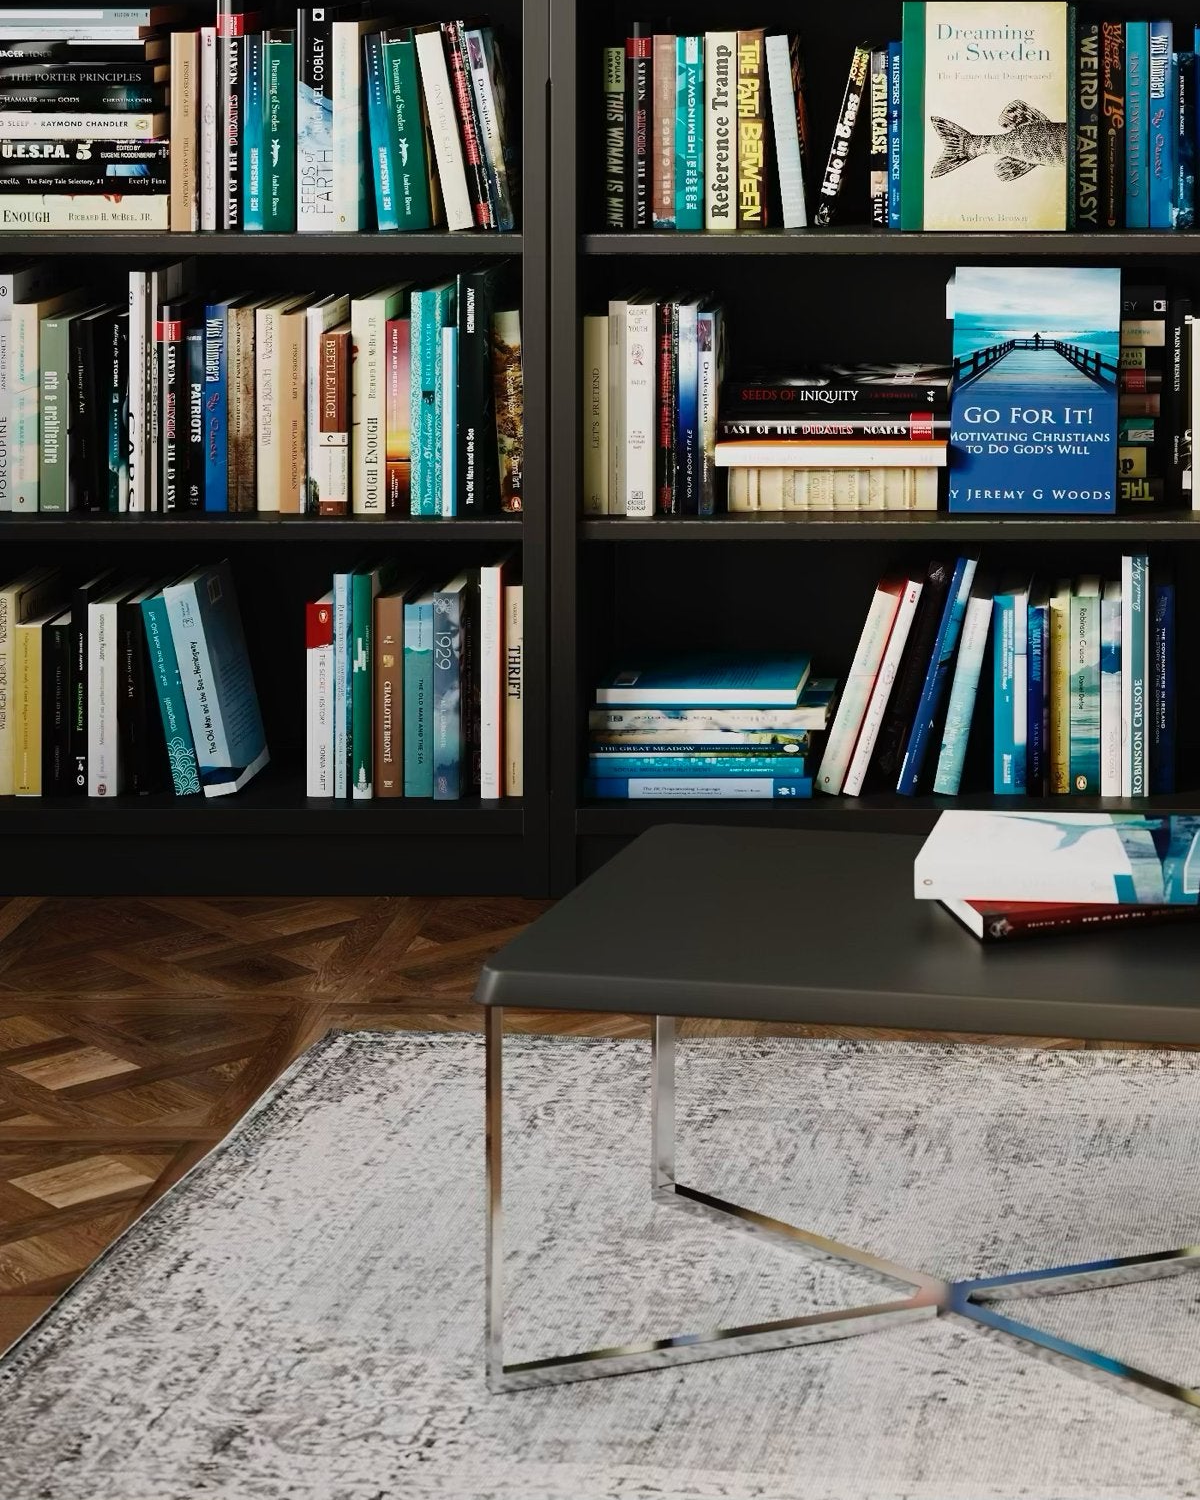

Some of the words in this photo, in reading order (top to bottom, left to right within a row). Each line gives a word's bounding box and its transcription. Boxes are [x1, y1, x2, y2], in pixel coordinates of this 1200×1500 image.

[740, 40, 760, 74] THE
[1080, 34, 1098, 110] WEIRD
[10, 73, 32, 82] THE
[34, 73, 76, 82] PORTER
[79, 73, 142, 82] PRINCIPLES
[270, 60, 280, 94] Dreaming
[712, 44, 732, 111] Tramp
[272, 96, 280, 104] of
[606, 92, 624, 121] THIS
[687, 68, 696, 152] HEMINGWAY
[739, 78, 760, 118] PATH
[836, 93, 860, 138] Brass
[870, 73, 888, 154] STAIRCASE
[272, 104, 280, 132] Sweden
[75, 143, 92, 161] 5
[606, 126, 624, 173] WOMAN
[712, 116, 730, 218] Reference
[832, 142, 848, 156] in
[606, 179, 624, 191] IS
[740, 122, 764, 220] BETWEEN
[821, 159, 844, 196] Halo
[1080, 125, 1098, 223] FANTASY
[3, 210, 50, 223] ENOUGH
[606, 197, 624, 228] MINE
[467, 288, 476, 334] HEMMINGWAY
[326, 340, 336, 418] BEETLEJUICE
[741, 390, 778, 401] SEEDS
[780, 390, 796, 401] OF
[800, 390, 858, 404] INIQUITY
[190, 383, 202, 444] PATRIOTS
[964, 407, 1000, 424] GO
[1010, 407, 1056, 424] FOR
[1064, 407, 1093, 424] IT!
[364, 417, 378, 464] ENOUGH
[364, 470, 378, 509] ROUGH
[966, 490, 1025, 501] JEREMY
[1032, 490, 1044, 500] G
[1052, 490, 1112, 500] WOODS
[1132, 558, 1145, 580] Defoe
[1132, 580, 1142, 612] Daniel
[1080, 608, 1088, 638] Robinson
[435, 632, 452, 670] 1929
[508, 645, 520, 700] THRIFT
[1132, 678, 1143, 728] CRUSOE
[1160, 690, 1166, 698] IN
[1132, 732, 1143, 794] ROBINSON
